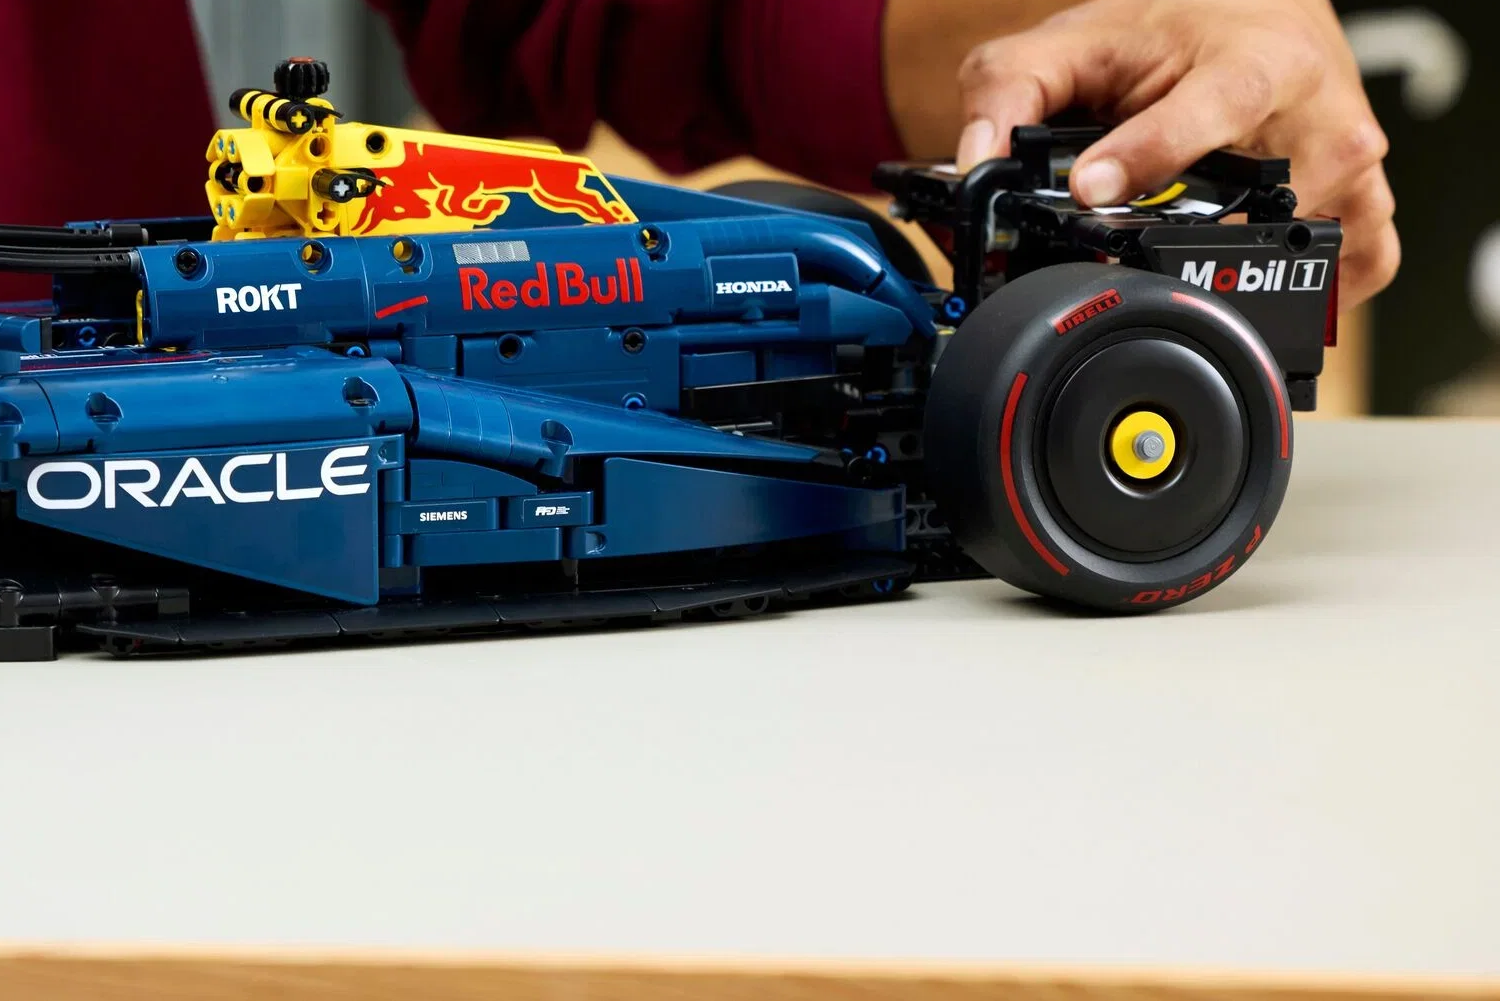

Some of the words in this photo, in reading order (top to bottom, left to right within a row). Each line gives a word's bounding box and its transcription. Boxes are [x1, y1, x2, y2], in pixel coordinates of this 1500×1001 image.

[458, 262, 550, 311] Red
[555, 257, 644, 306] Bull
[716, 280, 793, 294] HONDA
[1181, 260, 1287, 292] Mobil
[216, 283, 302, 314] ROKT
[1052, 288, 1122, 336] PIRELLI
[27, 445, 371, 509] ORACLE
[420, 511, 467, 522] SIEMENS
[1245, 524, 1261, 552] P
[1131, 555, 1235, 603] ZERO
